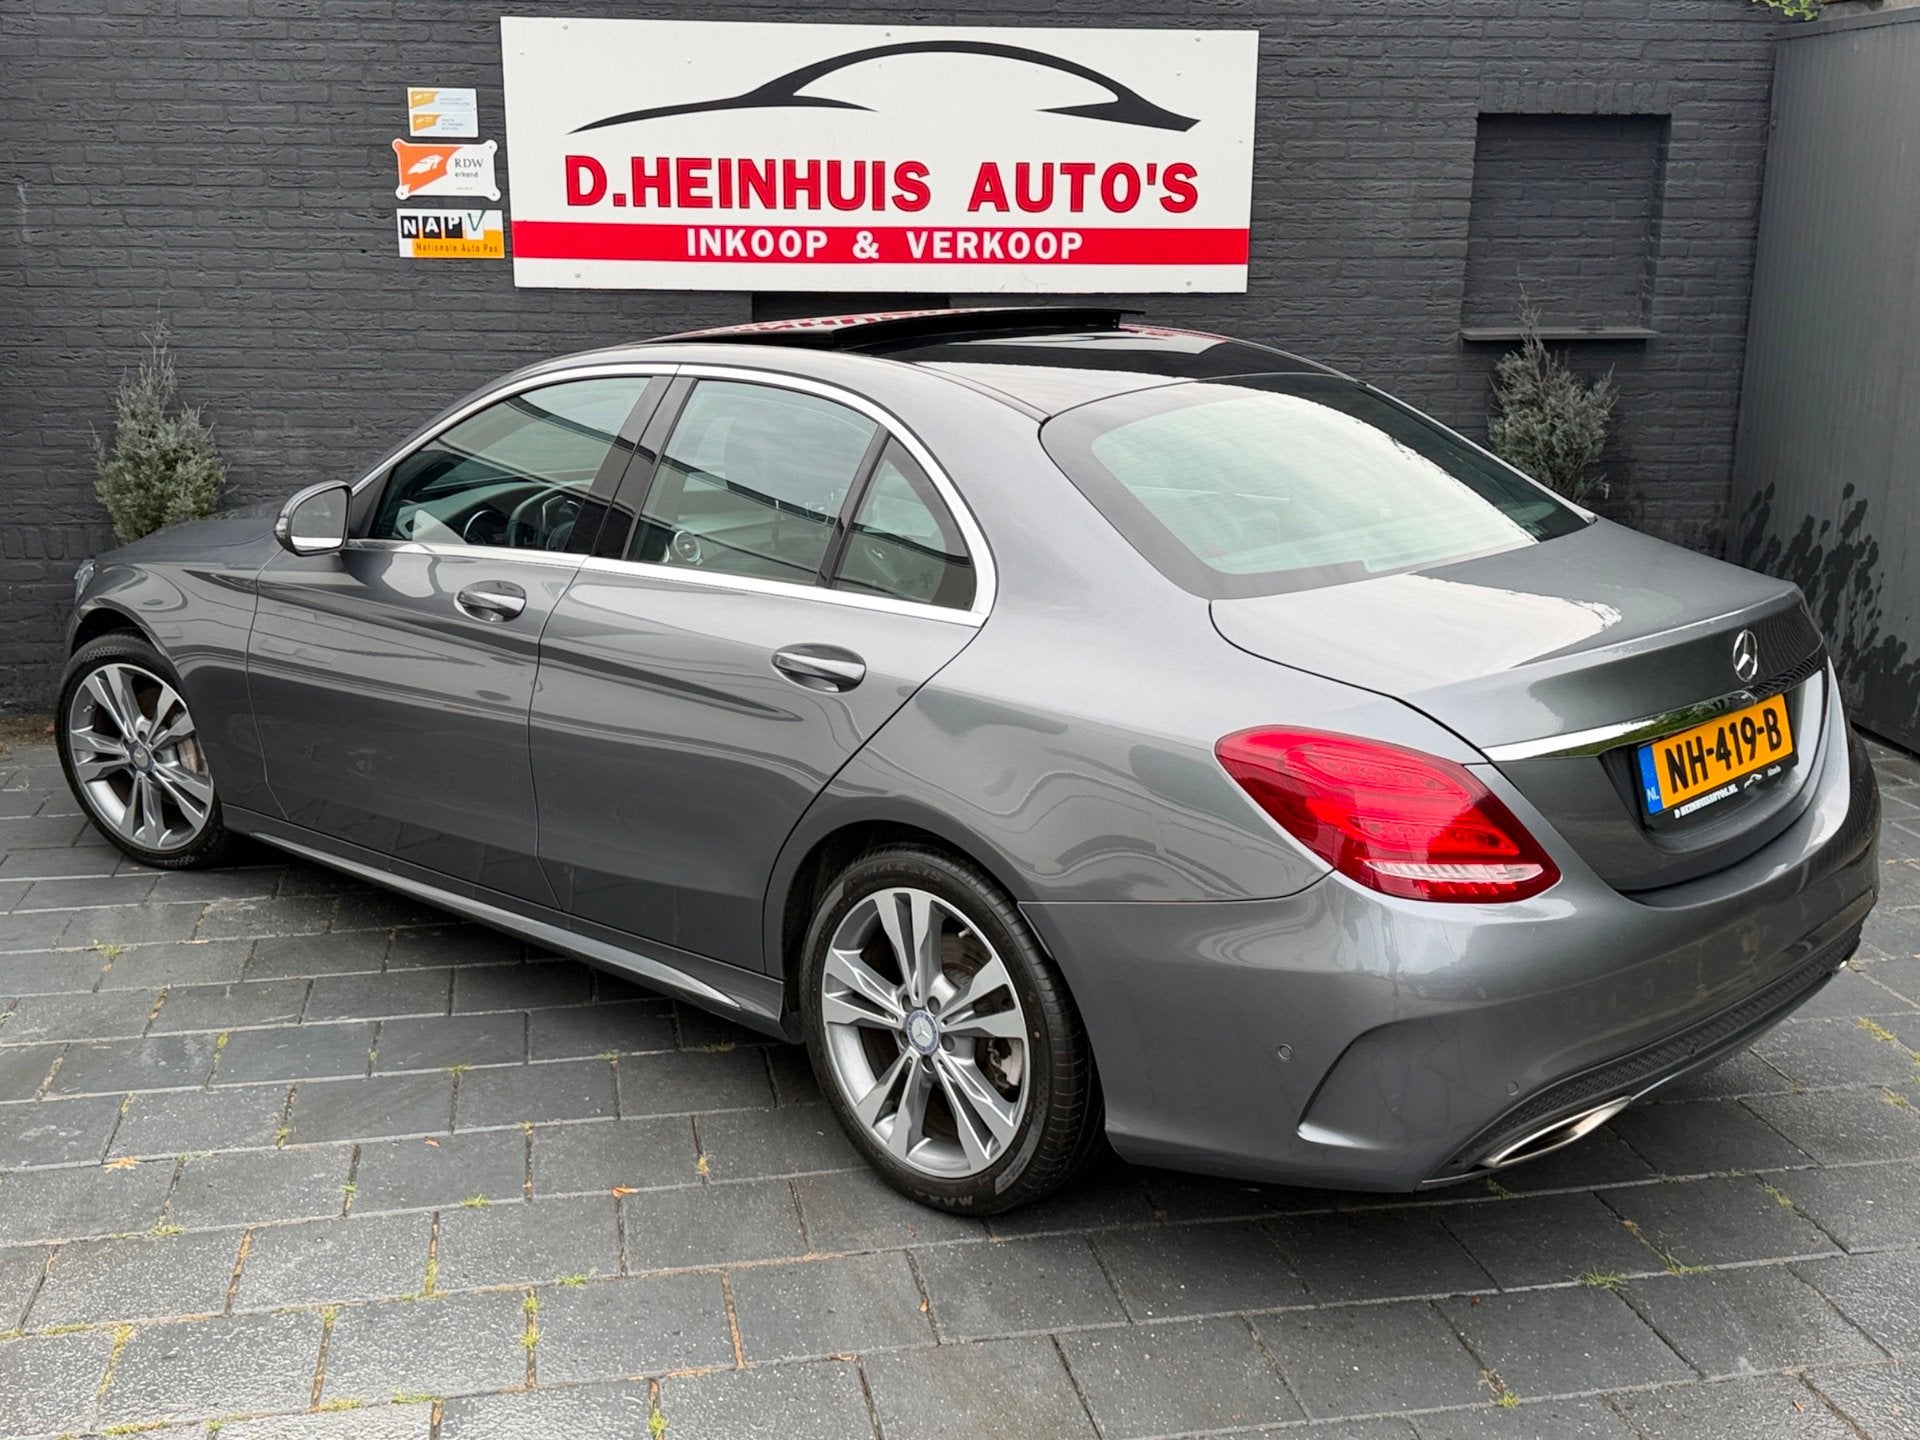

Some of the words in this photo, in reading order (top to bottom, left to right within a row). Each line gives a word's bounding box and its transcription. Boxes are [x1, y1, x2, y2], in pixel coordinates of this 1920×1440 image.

[454, 158, 484, 168] RDW
[565, 155, 931, 212] D.HEINHUIS
[967, 161, 1199, 213] AUTO'S
[416, 243, 457, 253] Nationale
[461, 243, 480, 253] Auto
[483, 244, 498, 253] Pas
[686, 228, 828, 258] INKOOP
[852, 231, 880, 259] &
[906, 231, 1083, 259] VERKOOP
[1664, 707, 1783, 794] NH-419-B
[1646, 786, 1660, 802] NL
